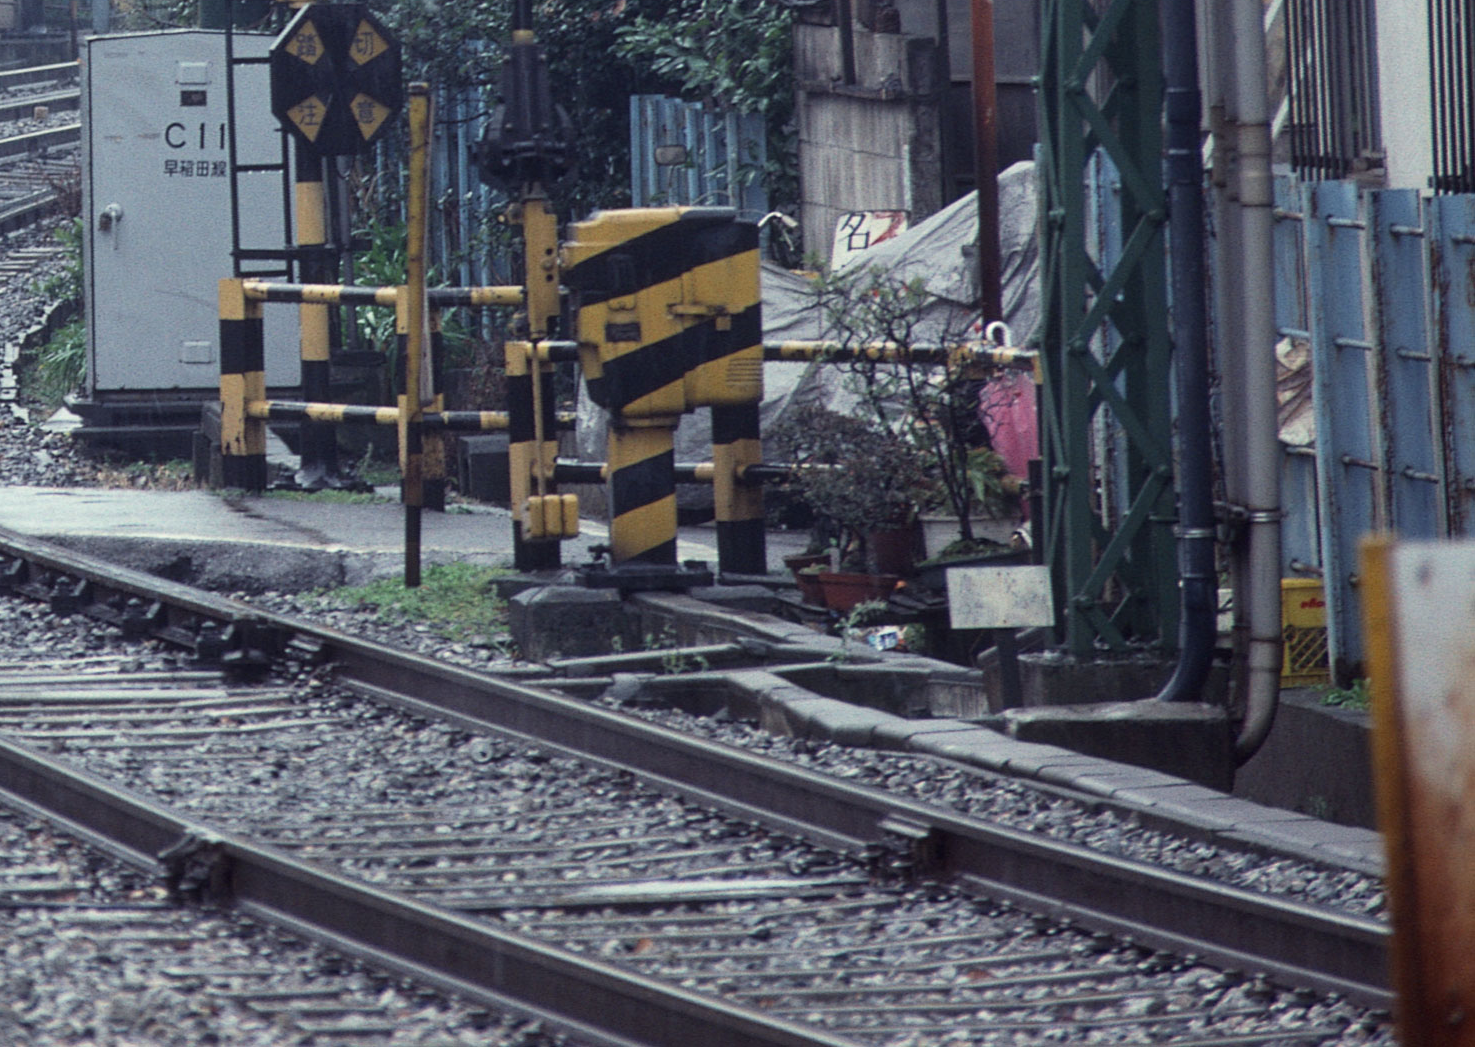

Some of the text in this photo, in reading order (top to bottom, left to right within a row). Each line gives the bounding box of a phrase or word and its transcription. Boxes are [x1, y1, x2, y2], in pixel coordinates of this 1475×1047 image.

[297, 100, 376, 127] 注意
[165, 122, 225, 150] C11
[164, 159, 227, 178] 早稲田線
